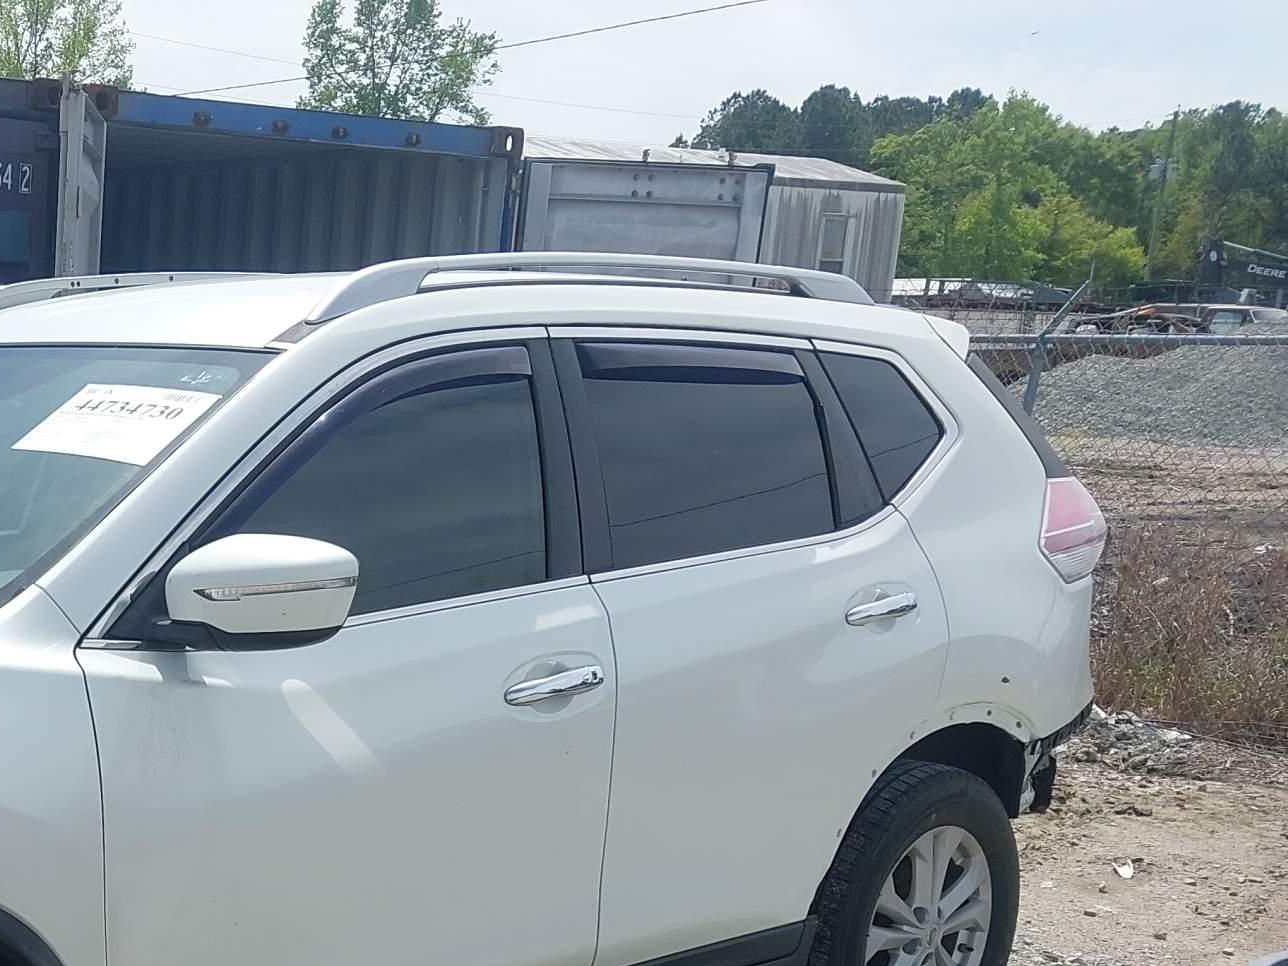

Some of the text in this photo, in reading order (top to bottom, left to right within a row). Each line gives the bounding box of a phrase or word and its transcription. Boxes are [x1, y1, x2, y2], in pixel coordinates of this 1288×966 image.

[20, 165, 31, 192] 2
[1247, 264, 1288, 279] DEERE
[74, 398, 184, 420] 44734730
